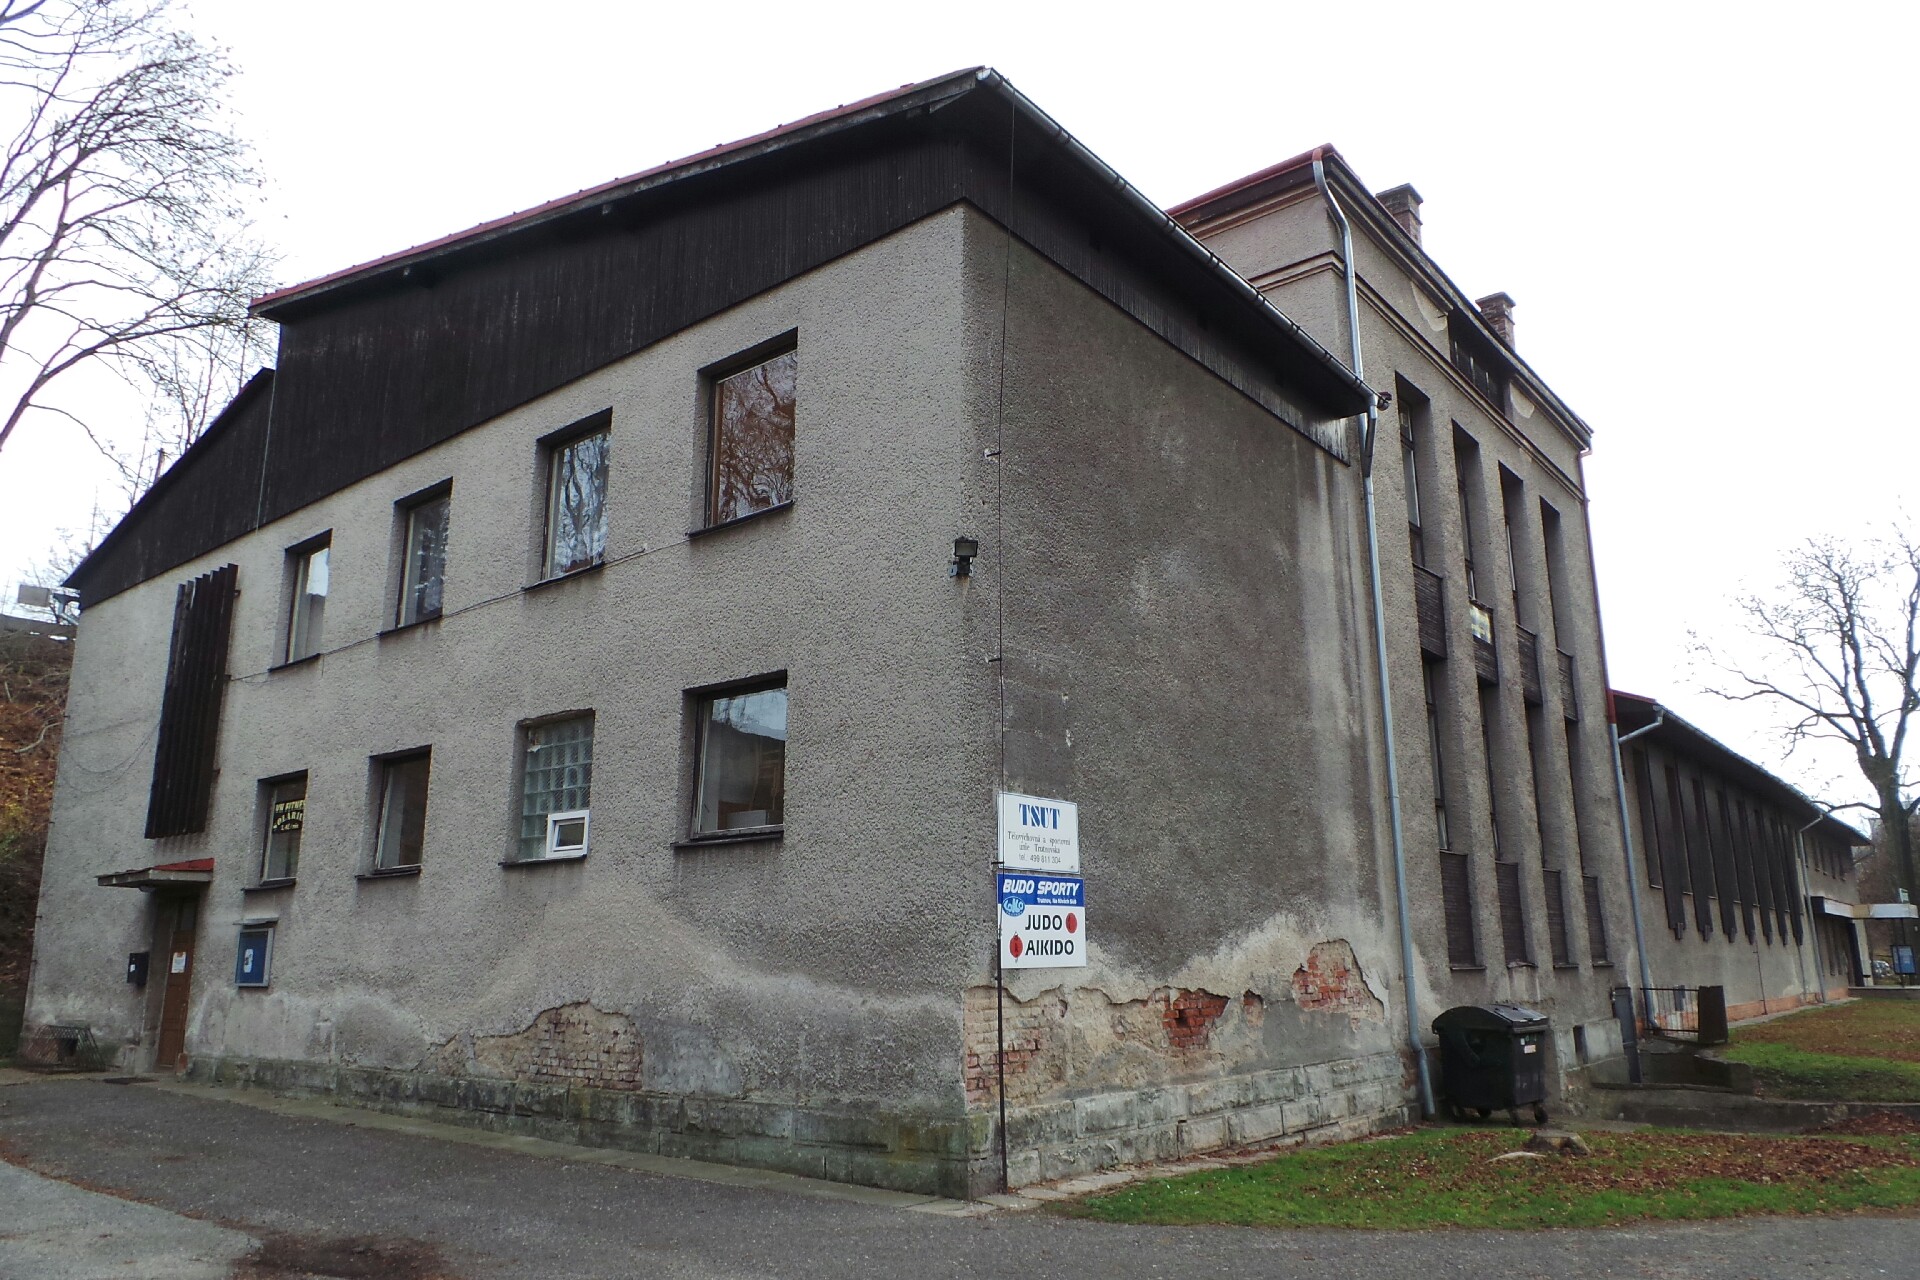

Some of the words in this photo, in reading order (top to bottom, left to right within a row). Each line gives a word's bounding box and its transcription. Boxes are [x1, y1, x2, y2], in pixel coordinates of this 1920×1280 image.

[1018, 803, 1060, 830] TSUT
[1002, 878, 1035, 894] BUDO
[1037, 880, 1080, 896] SPORTY
[1025, 914, 1063, 931] JUDO
[1025, 939, 1075, 956] AIKIDO
